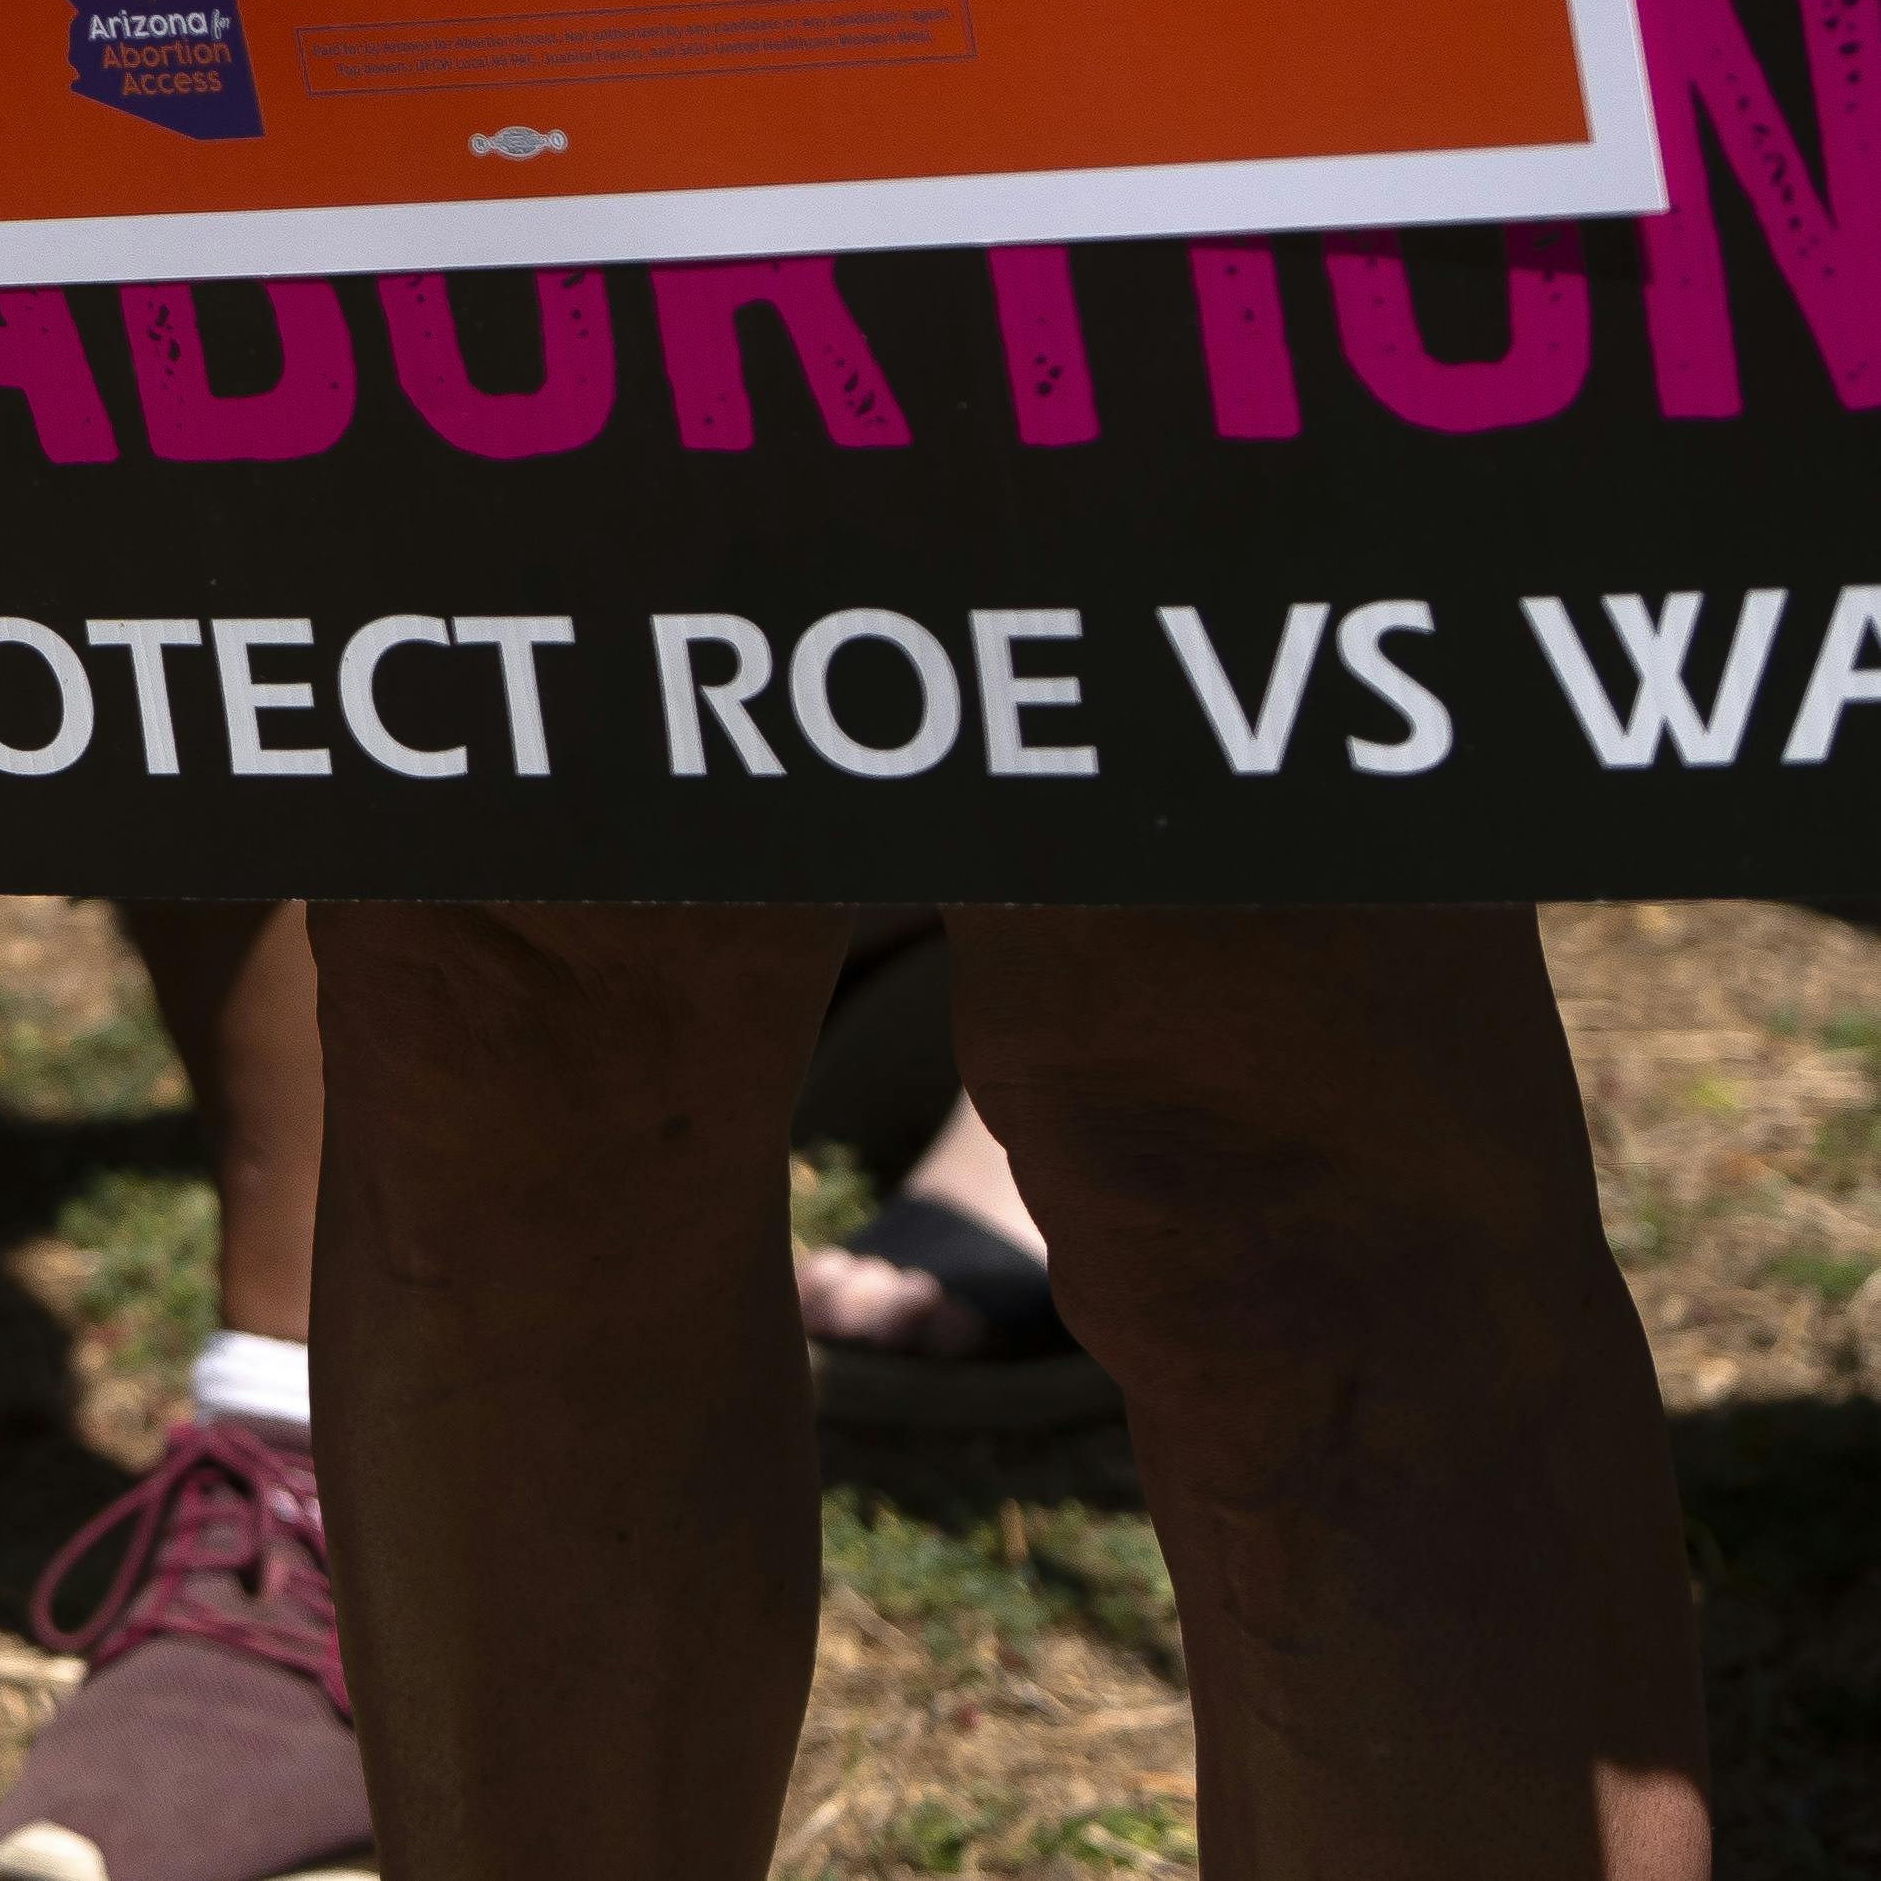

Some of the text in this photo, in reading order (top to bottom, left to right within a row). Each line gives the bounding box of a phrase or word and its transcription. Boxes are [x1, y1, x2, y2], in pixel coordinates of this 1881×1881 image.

[88, 9, 209, 41] Arizona
[103, 39, 232, 68] Abortion
[123, 70, 222, 96] Access
[652, 608, 1098, 778] ROE
[1157, 600, 1452, 775] VS
